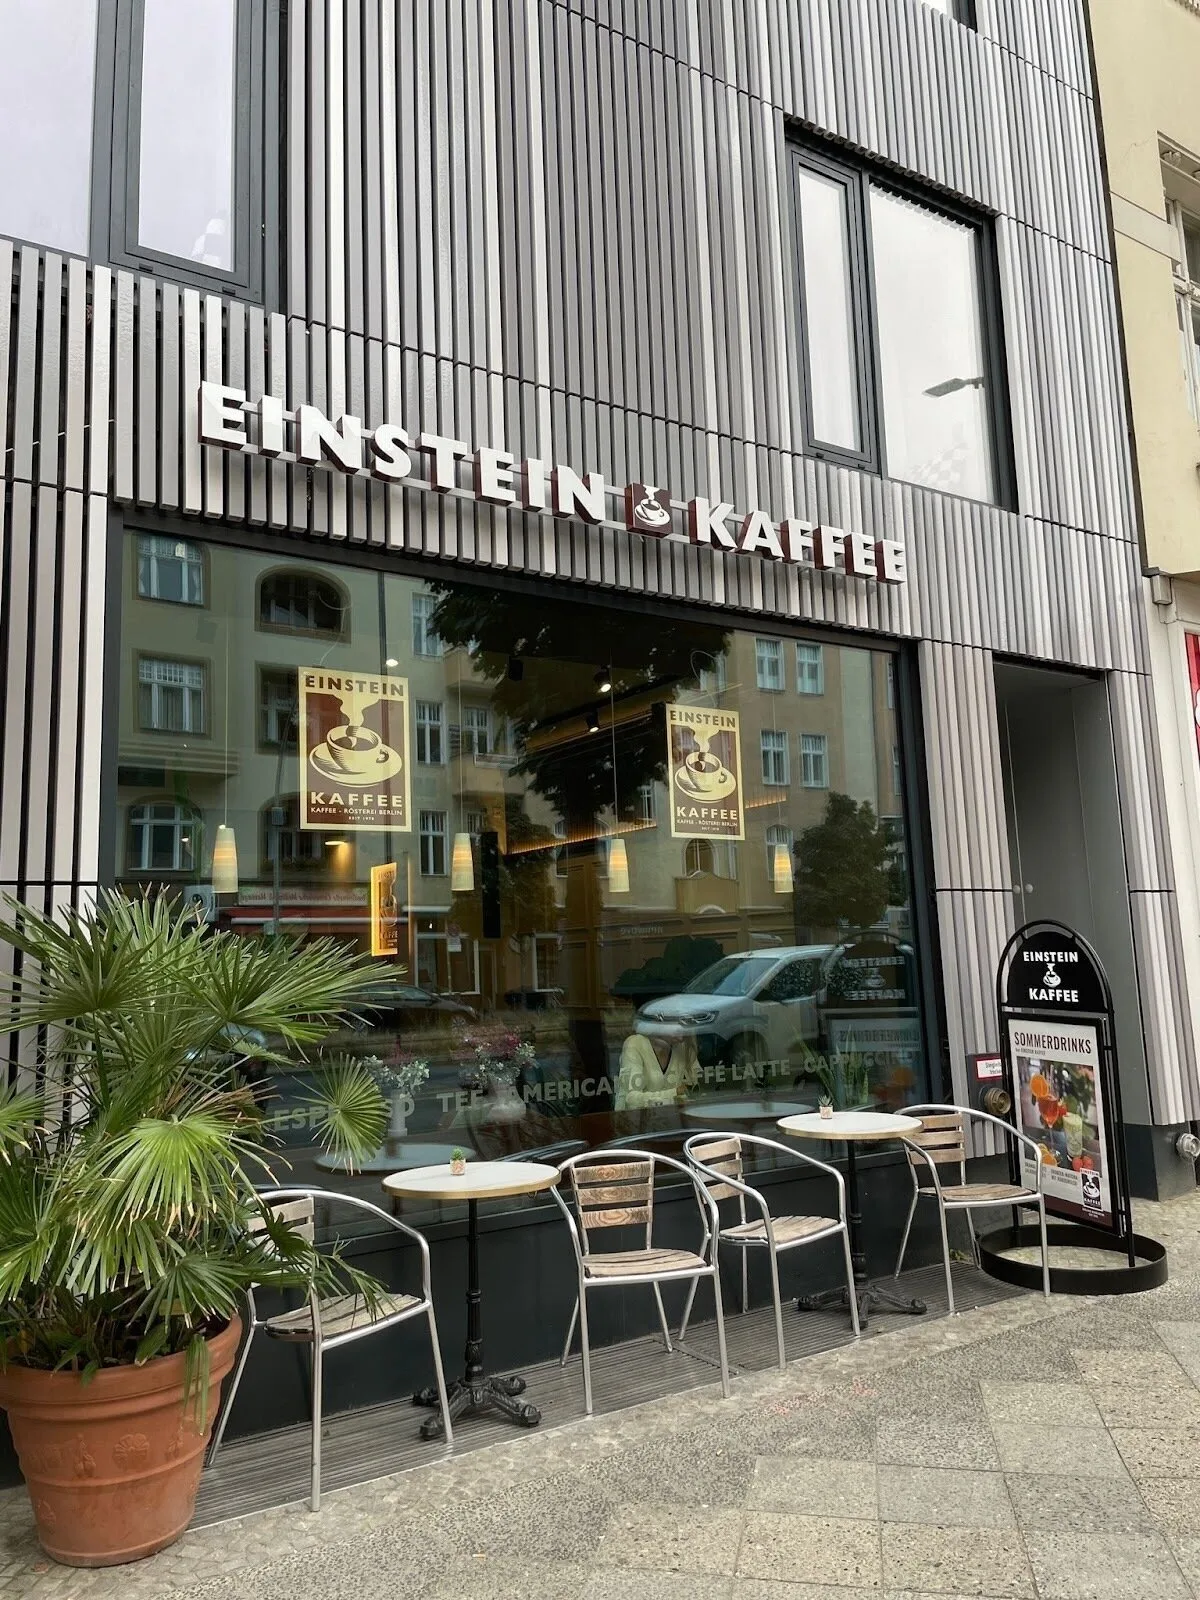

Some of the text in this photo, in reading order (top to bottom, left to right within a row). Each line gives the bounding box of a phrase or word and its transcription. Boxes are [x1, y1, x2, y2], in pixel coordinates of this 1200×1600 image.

[199, 380, 907, 585] EINSTEIN KAFFEE
[305, 674, 404, 697] EINSTEIN
[669, 710, 736, 728] EINSTEIN
[310, 791, 402, 807] KAFFEE
[676, 806, 738, 820] KAFFEE
[1022, 950, 1079, 963] EINSTEIN
[1028, 987, 1079, 1003] KAFFEE
[1014, 1031, 1092, 1055] SOMMERDRINKS
[731, 1058, 791, 1082] LATTE
